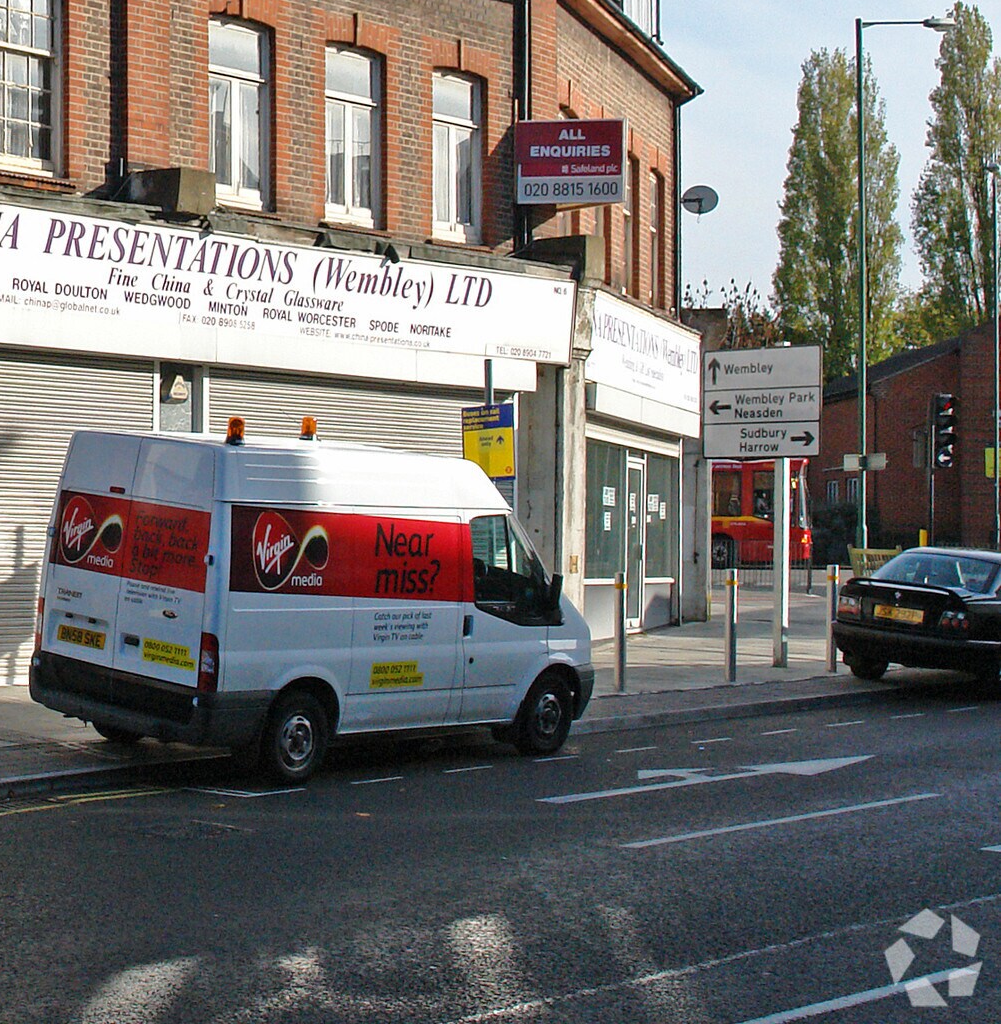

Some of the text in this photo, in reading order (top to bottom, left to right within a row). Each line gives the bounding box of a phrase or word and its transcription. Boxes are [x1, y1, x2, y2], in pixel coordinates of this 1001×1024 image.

[558, 129, 586, 140] ALL
[530, 145, 611, 157] ENQUIRIES
[570, 164, 618, 174] Safeland plc
[524, 182, 618, 196] 020 8815 1600
[42, 218, 298, 285] PRESENTATIONS
[312, 256, 434, 310] (Wembley)
[445, 273, 494, 309] LTD
[107, 267, 344, 312] Fine China & Crystal Glassware
[12, 277, 451, 338] ROYAL DOULTON WEDGWOOD MINTON ROYAL WORCESTER SPODE NORITAKE
[202, 316, 216, 326] 020
[511, 348, 521, 356] 020
[724, 363, 773, 375] Wembley
[735, 392, 815, 405] Wembley Park
[734, 408, 783, 419] Neasden
[740, 428, 787, 440] Sudbury
[739, 442, 779, 452] Harrow
[64, 507, 94, 551] Virgin
[375, 523, 434, 557] Near
[257, 524, 294, 575] Virgin
[87, 554, 113, 567] media
[292, 573, 322, 587] media
[375, 560, 440, 594] miss?
[374, 612, 390, 621] Catch
[373, 633, 390, 643] Virgin
